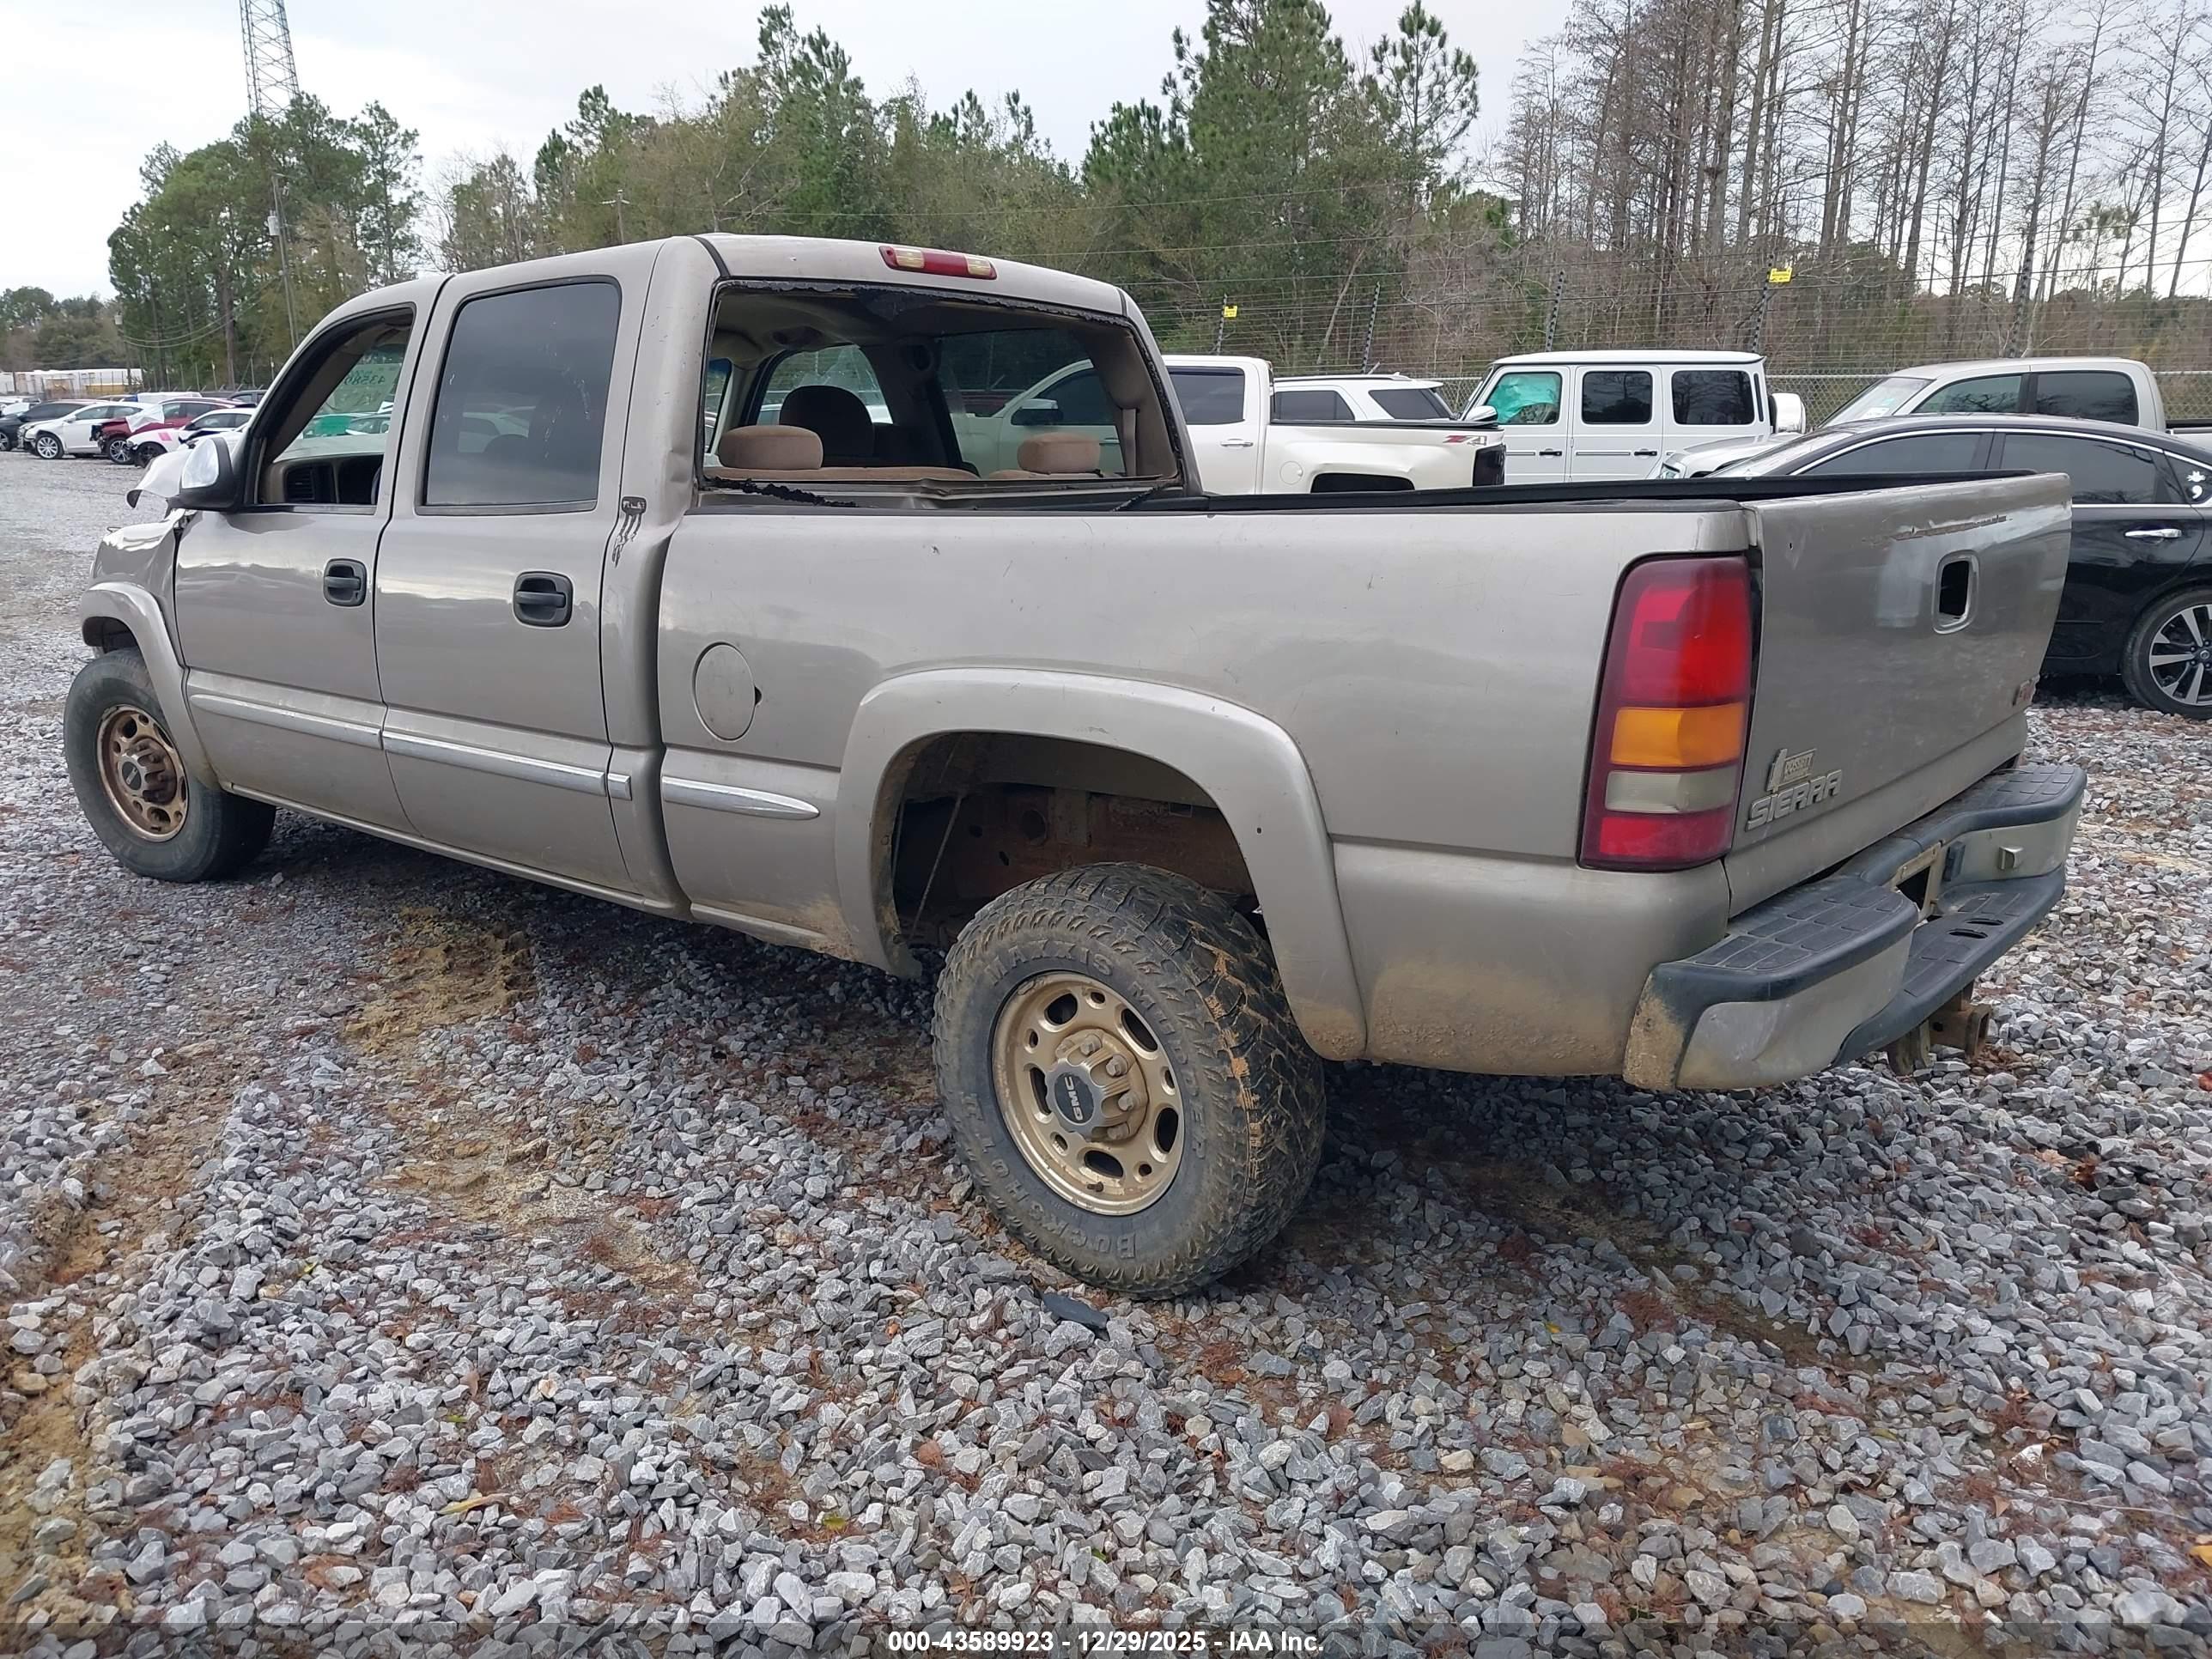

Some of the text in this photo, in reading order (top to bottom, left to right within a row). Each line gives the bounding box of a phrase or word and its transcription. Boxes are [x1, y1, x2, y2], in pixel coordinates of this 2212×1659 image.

[1745, 769, 1843, 832] SIERRA
[983, 939, 1115, 985] MAXXIS
[1064, 1075, 1084, 1121] GMC
